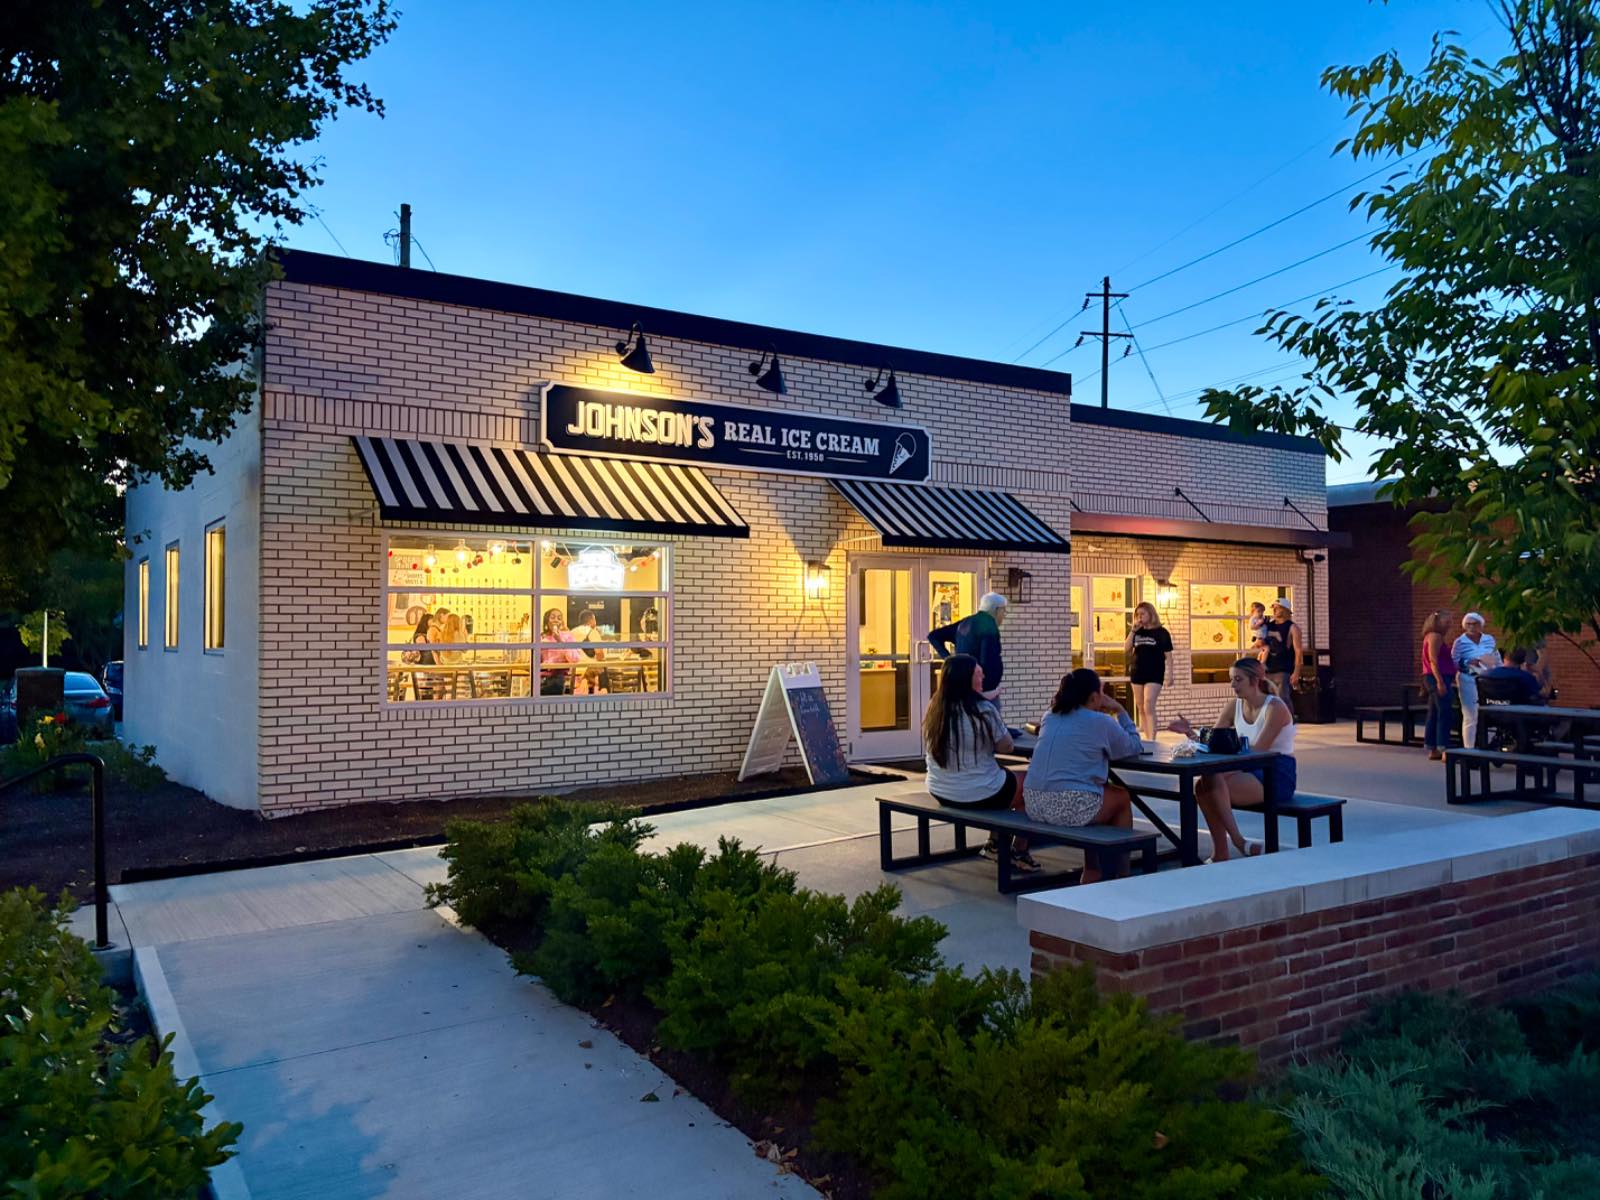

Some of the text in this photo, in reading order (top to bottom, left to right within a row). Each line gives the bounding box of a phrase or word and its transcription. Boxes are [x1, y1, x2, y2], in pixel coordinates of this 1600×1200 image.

[566, 400, 880, 456] JOHNSON'S REAL ICE CREAM
